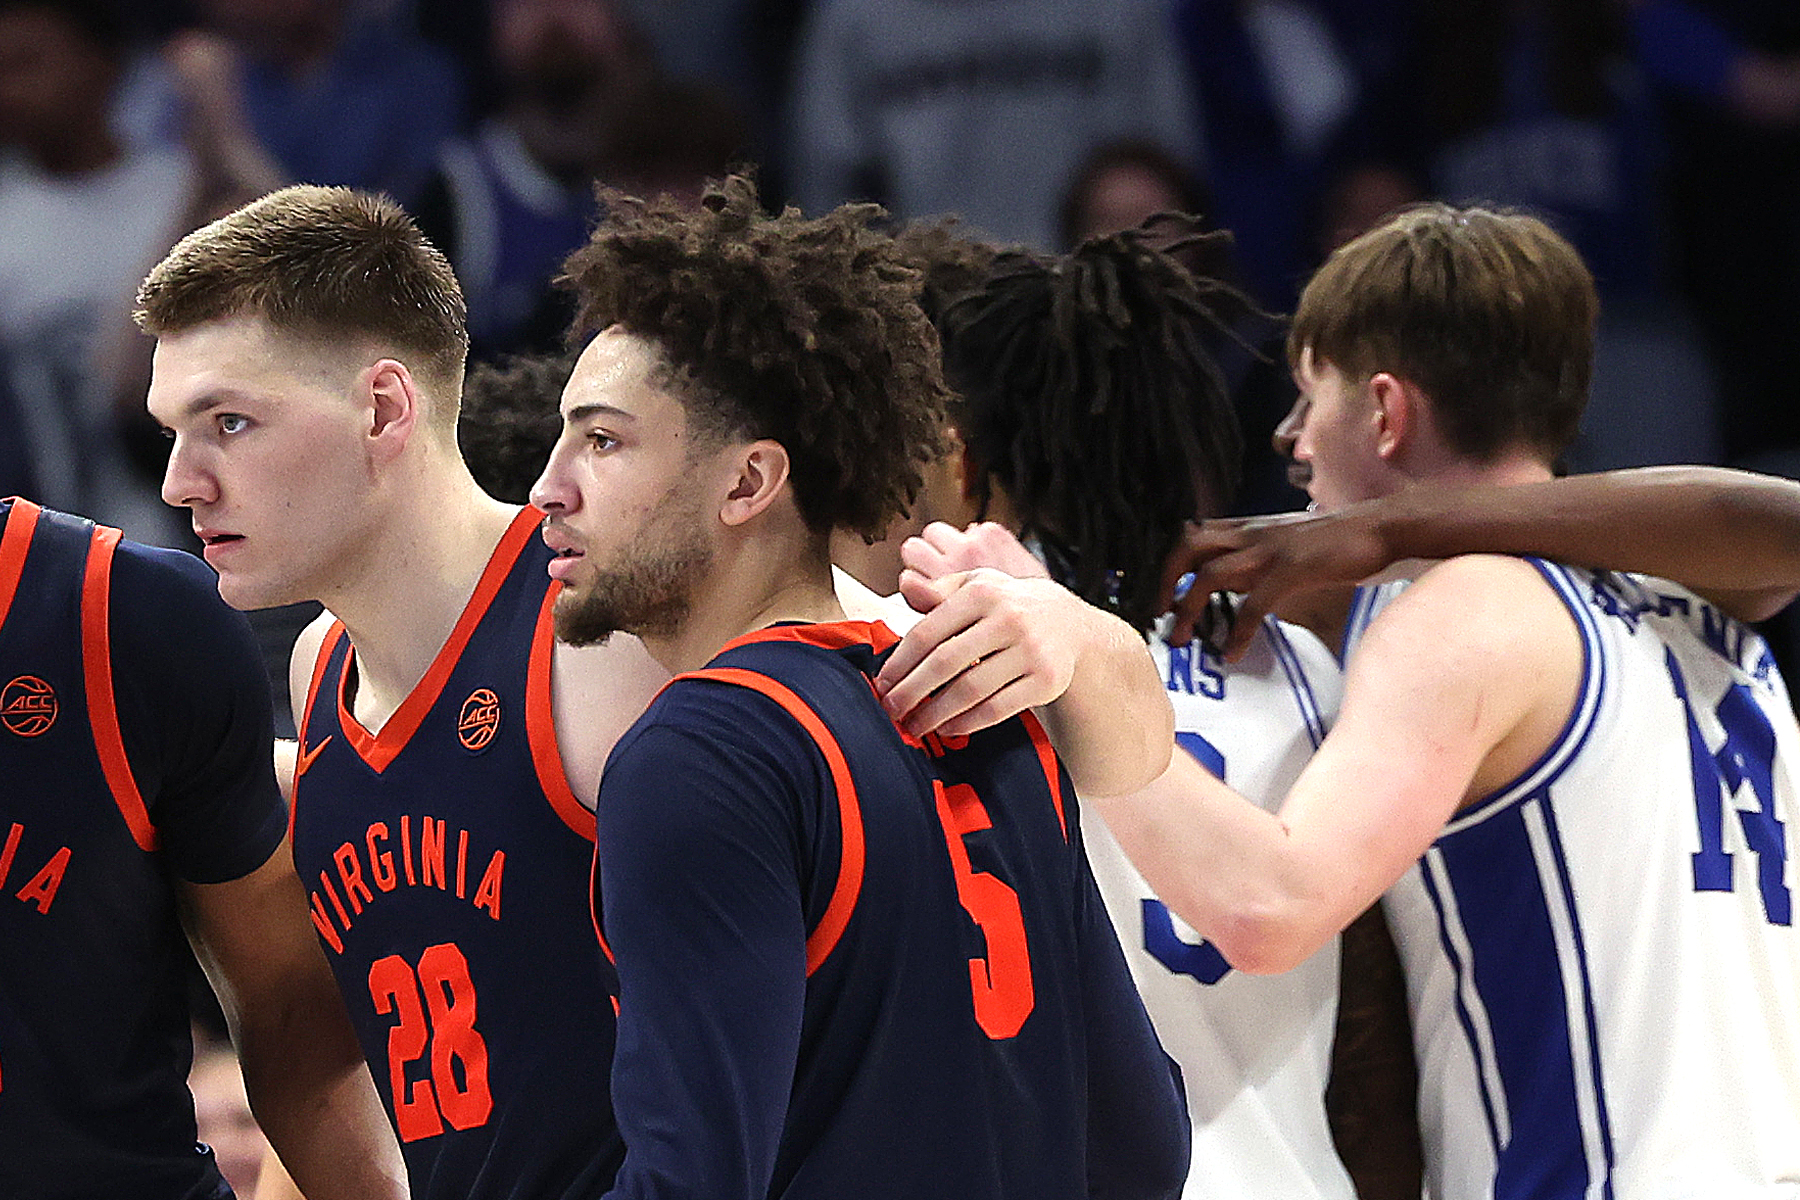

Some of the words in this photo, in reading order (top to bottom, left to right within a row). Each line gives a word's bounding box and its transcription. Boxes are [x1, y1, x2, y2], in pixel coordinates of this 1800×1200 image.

[7, 696, 53, 711] ACC
[463, 704, 498, 724] ACC
[310, 815, 506, 955] VIRGINIA
[932, 779, 1035, 1040] 5
[368, 942, 494, 1144] 28
